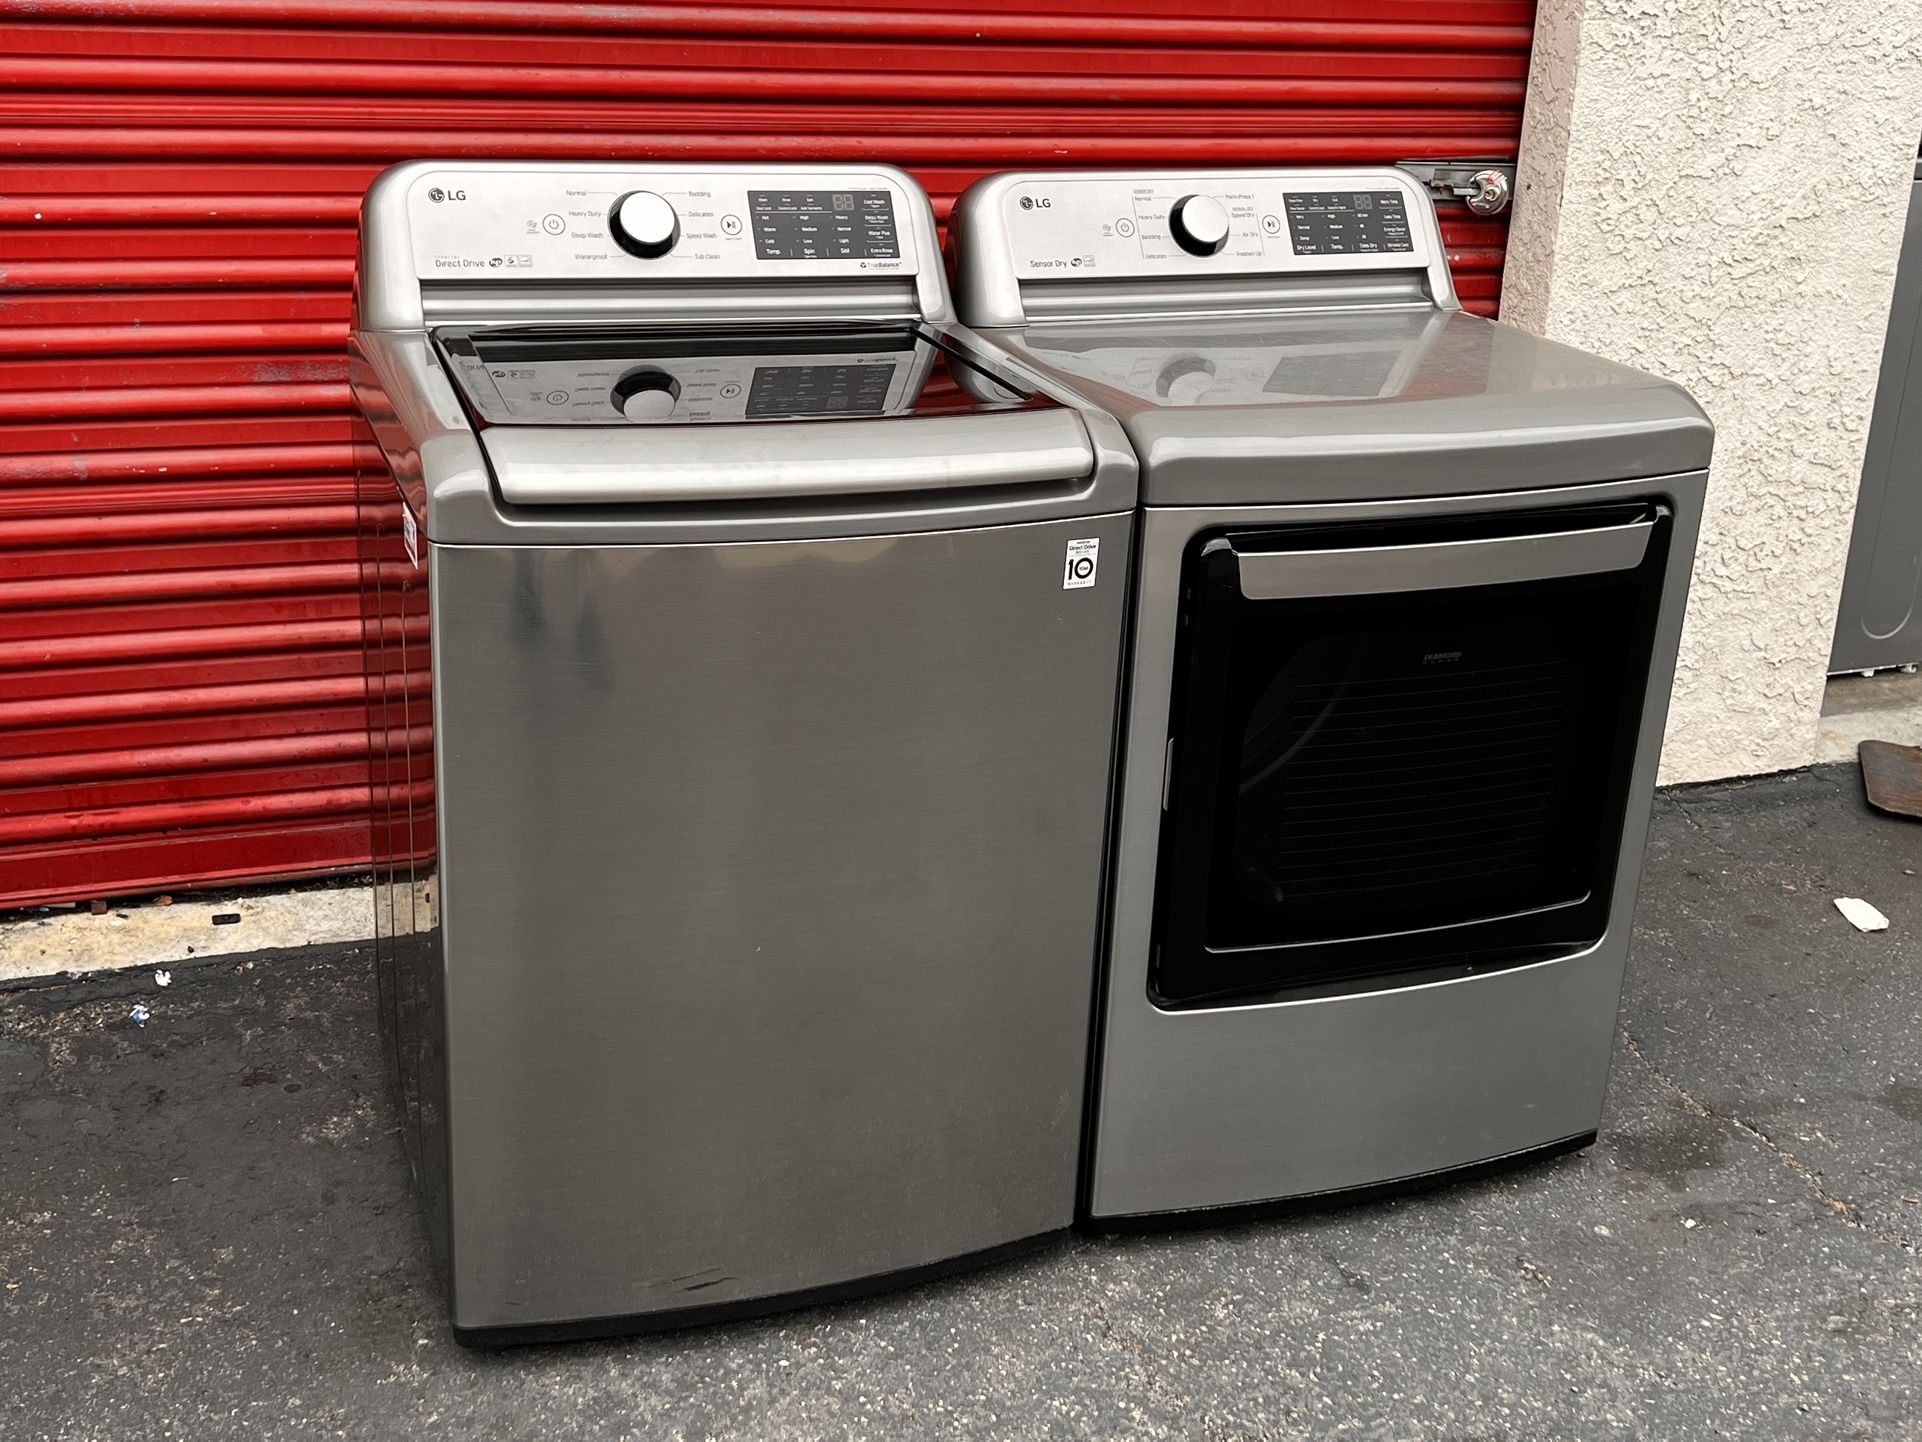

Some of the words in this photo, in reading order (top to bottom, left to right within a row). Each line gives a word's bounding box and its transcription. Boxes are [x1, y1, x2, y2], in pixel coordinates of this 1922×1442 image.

[447, 190, 466, 201] LG
[1035, 198, 1051, 208] LG
[435, 259, 461, 267] Direct
[462, 259, 485, 267] Drive
[1030, 260, 1054, 268] Sensor
[1054, 260, 1068, 268] Dry
[1068, 557, 1094, 580] 10
